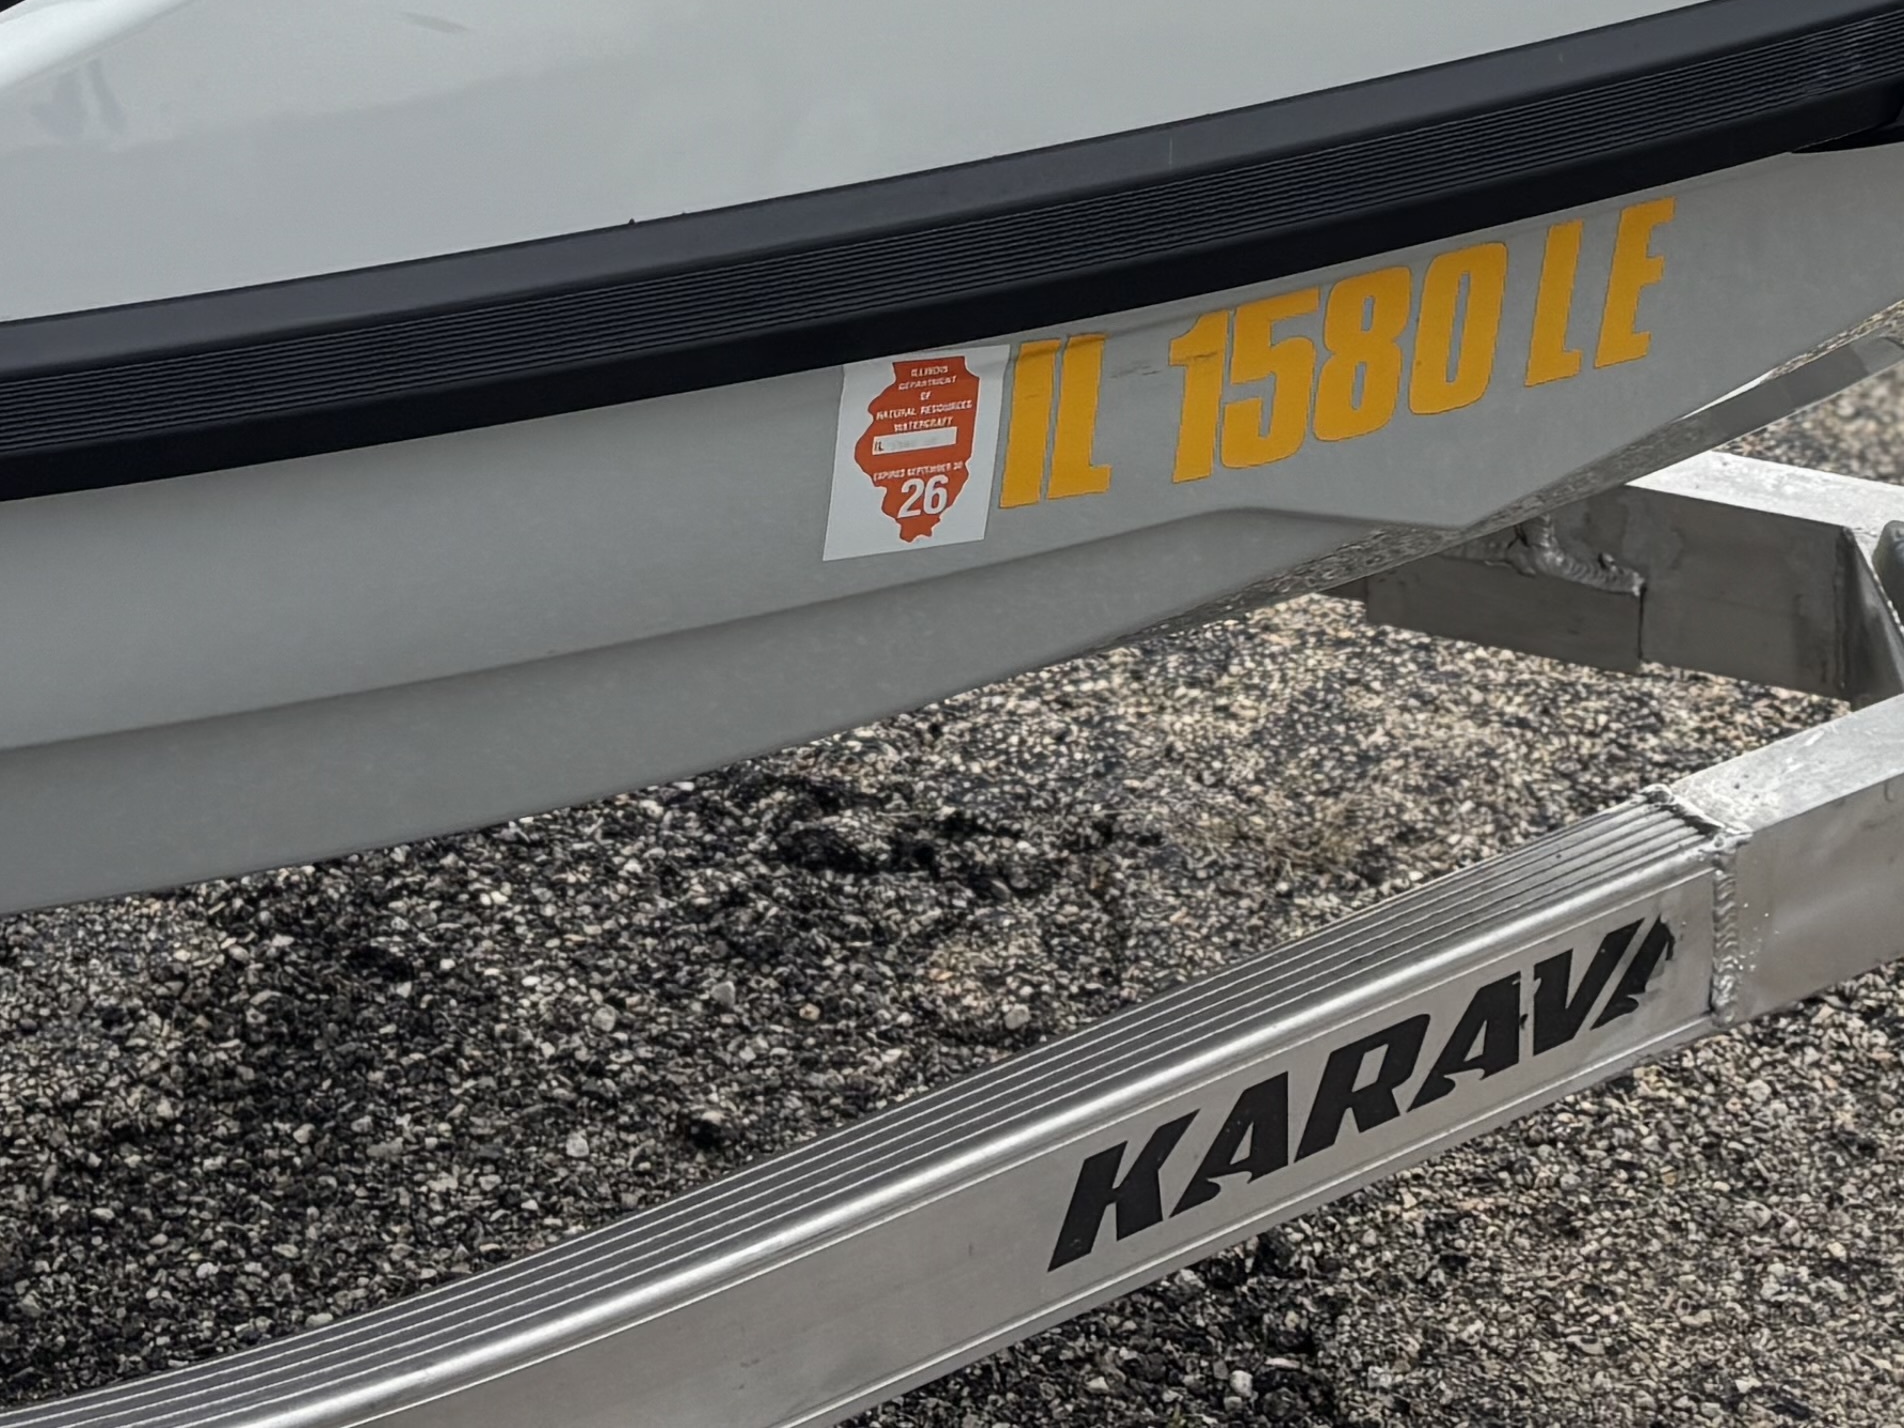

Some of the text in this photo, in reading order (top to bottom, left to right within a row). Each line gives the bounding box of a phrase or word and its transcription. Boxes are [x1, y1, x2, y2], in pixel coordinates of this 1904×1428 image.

[997, 197, 1676, 509] IL 1580 LE
[897, 474, 950, 519] 26
